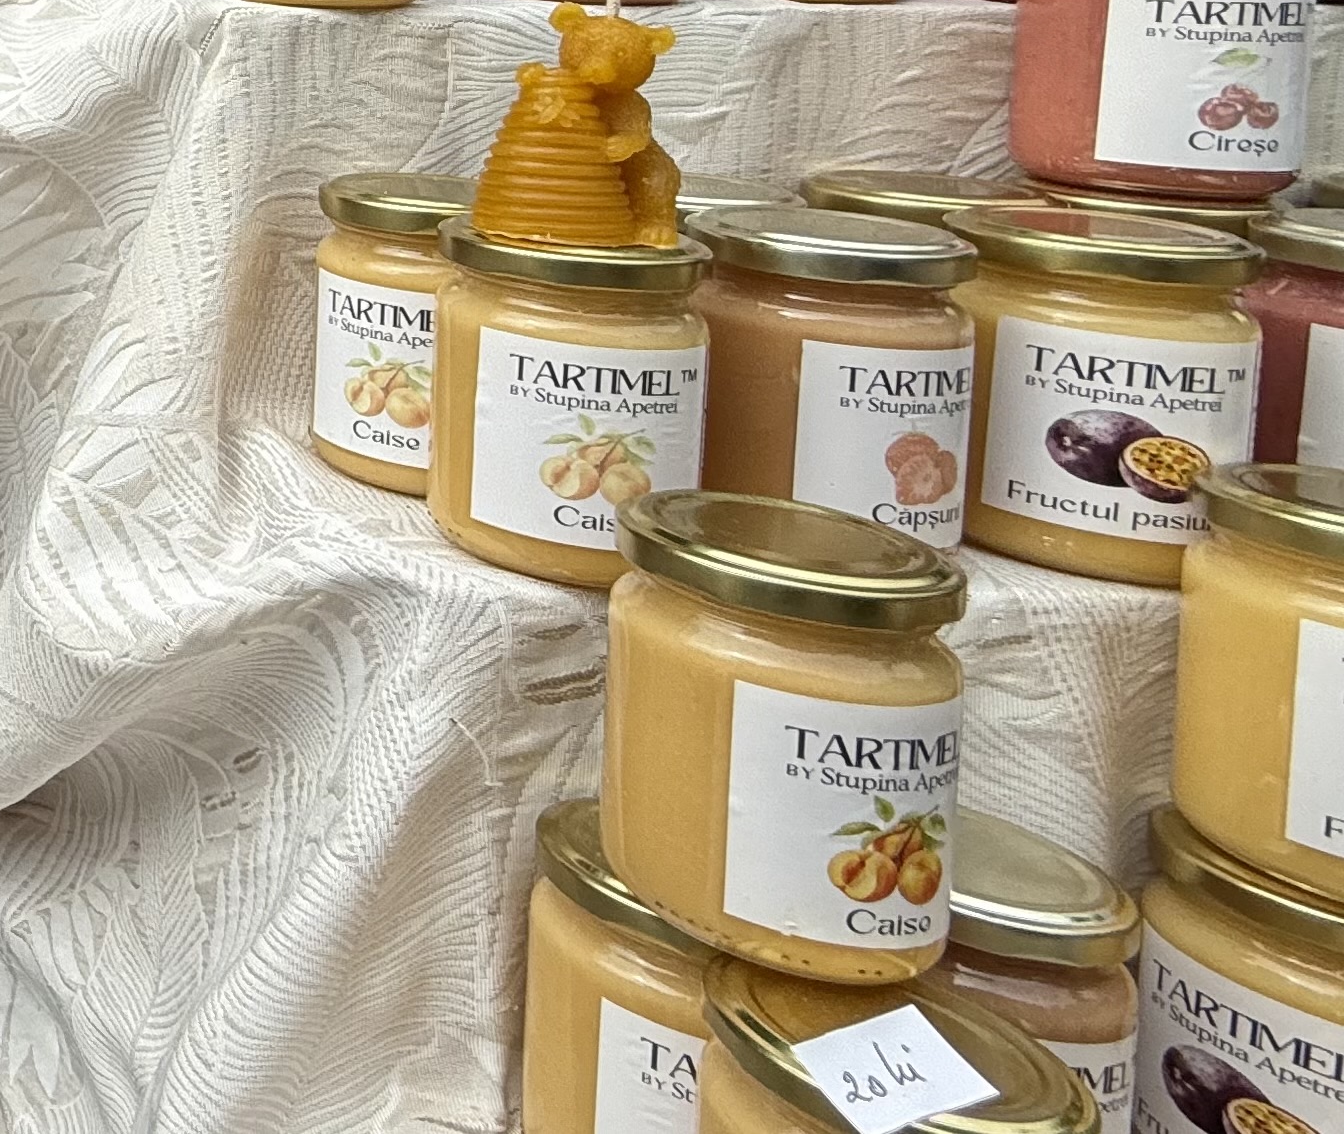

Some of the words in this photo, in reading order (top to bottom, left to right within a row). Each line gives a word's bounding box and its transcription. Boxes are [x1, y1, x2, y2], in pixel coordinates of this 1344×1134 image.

[1145, 27, 1171, 38] BY
[1174, 26, 1253, 45] Stupina
[328, 288, 435, 333] TARTIME
[341, 318, 394, 344] Stupina
[509, 353, 698, 397] TARTIMEL™
[1026, 343, 1247, 395] TARTIMEL™
[509, 384, 529, 398] BY
[534, 386, 611, 413] Stupina
[614, 396, 679, 418] Apetrei
[839, 397, 863, 409] BY
[867, 395, 937, 417] Stupina
[1025, 374, 1050, 389] BY
[1053, 377, 1146, 407] Stupina
[352, 420, 421, 451] Caise
[553, 505, 616, 533] Cais
[1006, 478, 1120, 524] Fructul
[1131, 508, 1212, 538] pasiu
[786, 763, 816, 780] BY
[820, 766, 911, 794] Stupina
[845, 908, 932, 937] Caise
[1168, 1004, 1250, 1064] Stupina
[1255, 1055, 1344, 1106] Apetre
[640, 1070, 669, 1093] BY
[842, 1070, 886, 1106] 20
